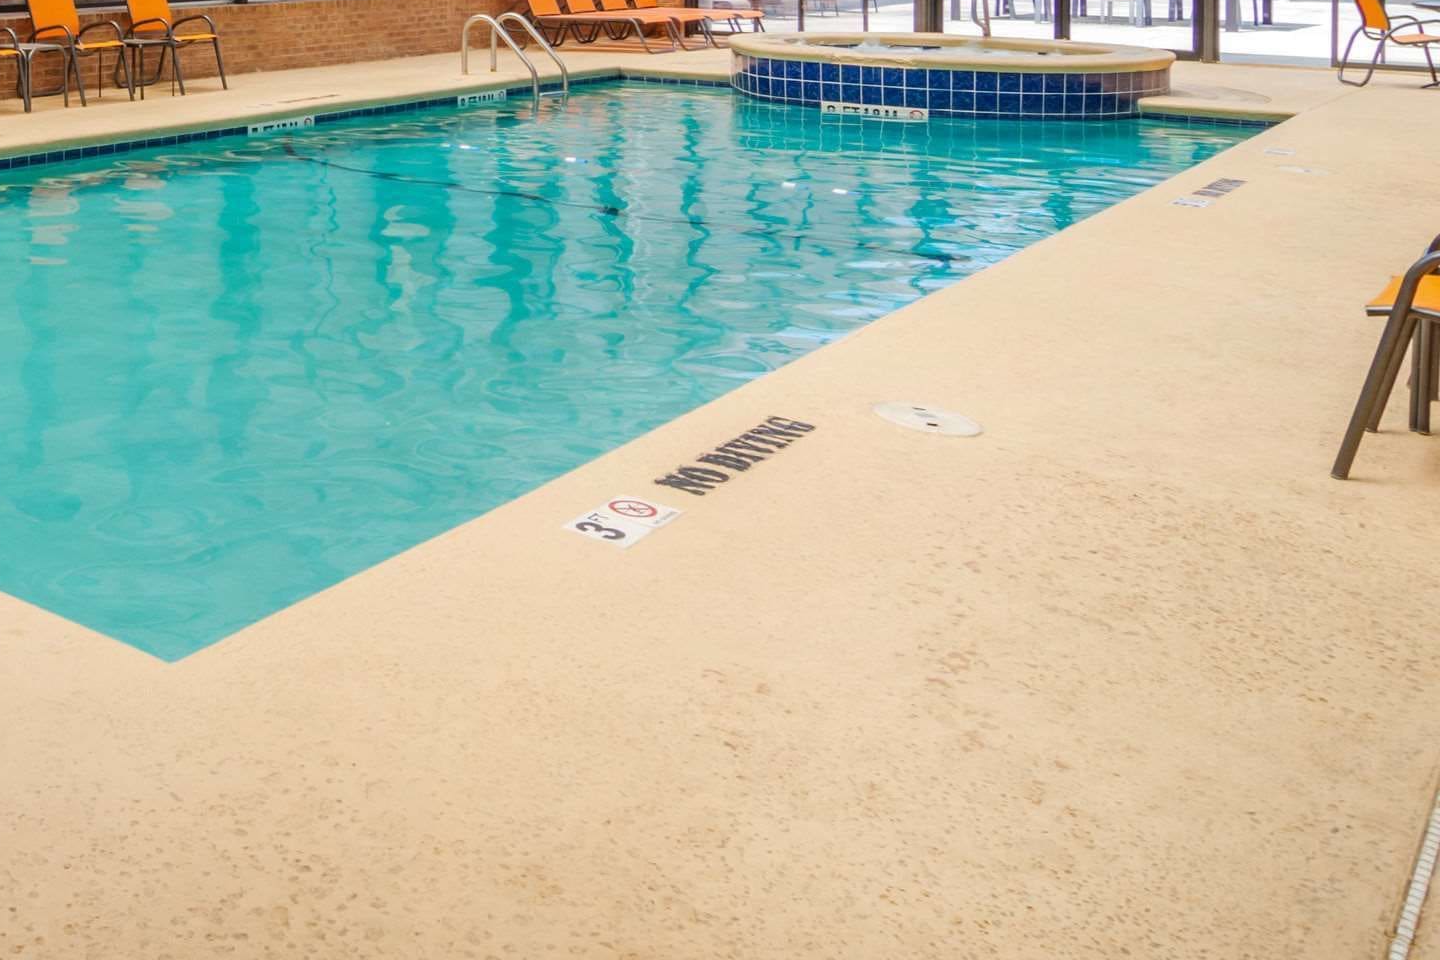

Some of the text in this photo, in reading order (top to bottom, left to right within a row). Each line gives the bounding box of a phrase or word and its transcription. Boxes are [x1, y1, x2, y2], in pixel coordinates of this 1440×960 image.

[654, 415, 817, 496] NO DIVING
[575, 521, 626, 541] 3
